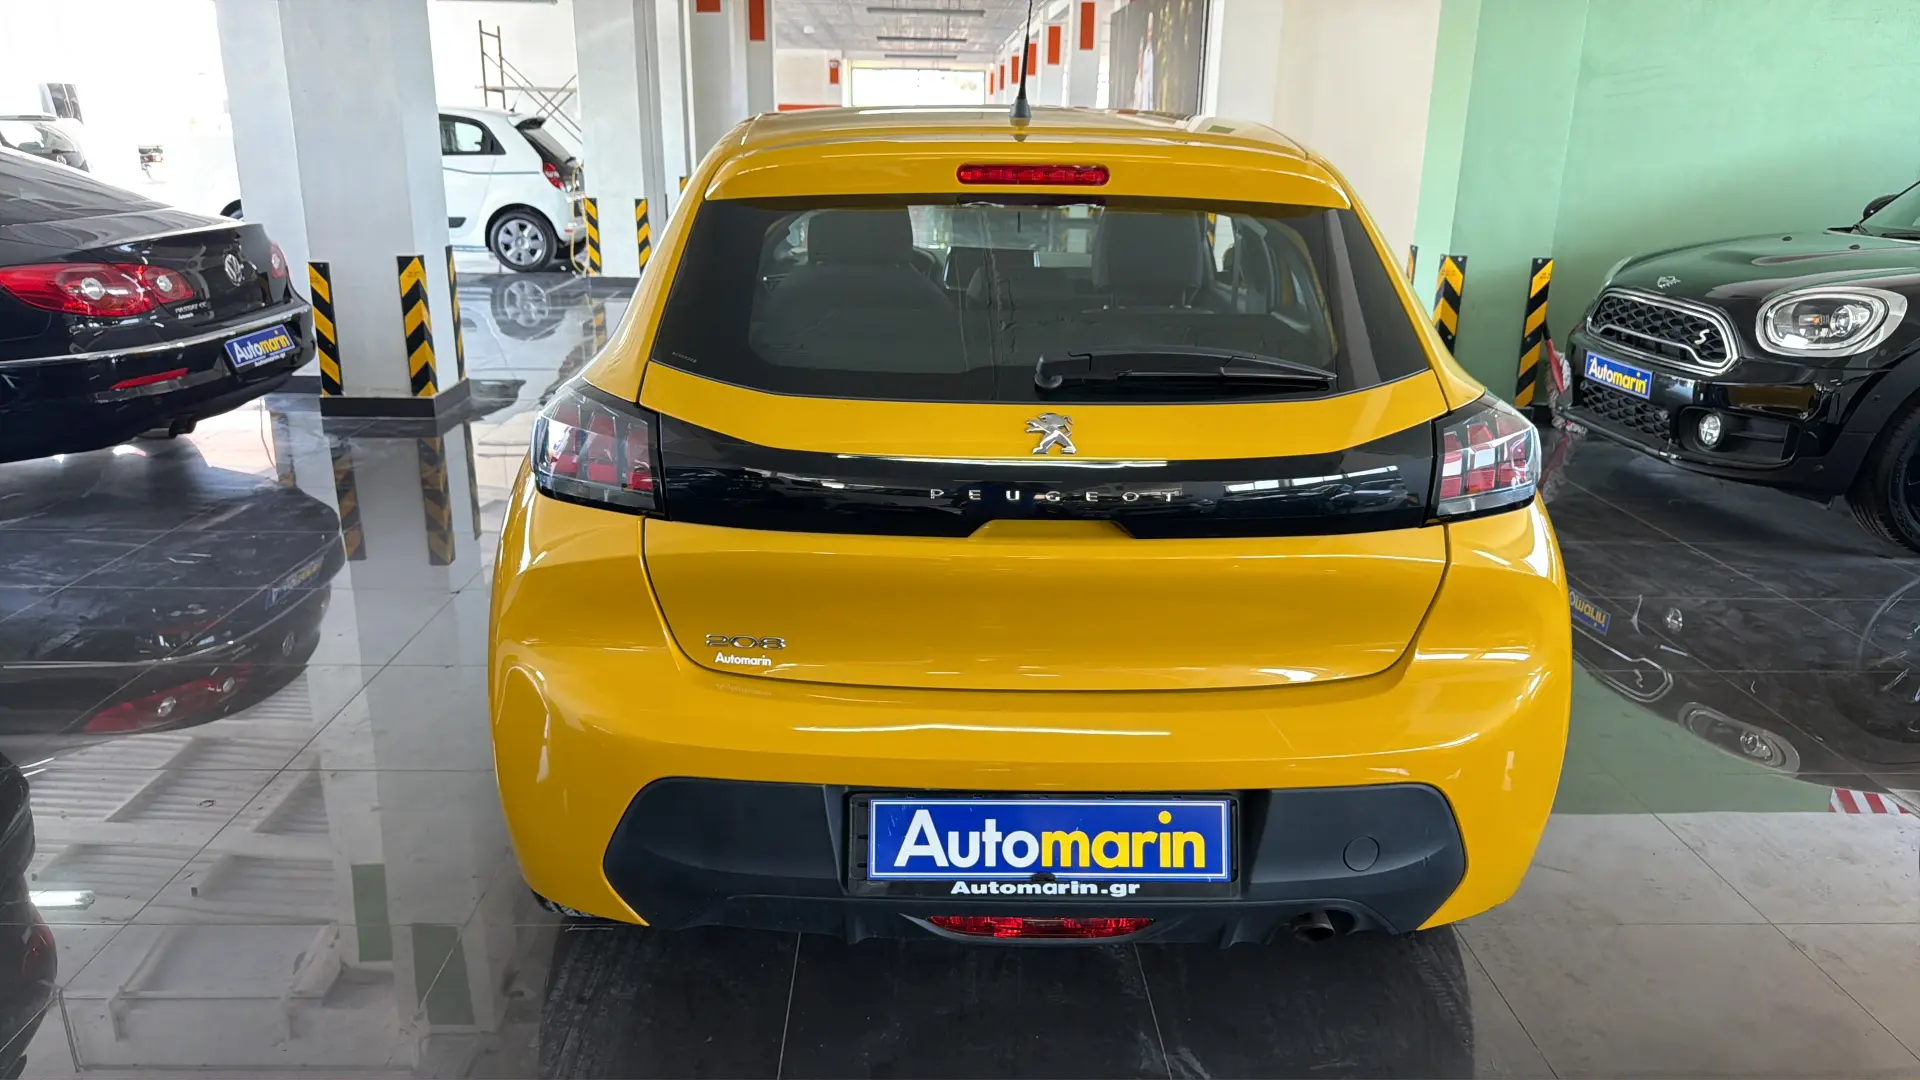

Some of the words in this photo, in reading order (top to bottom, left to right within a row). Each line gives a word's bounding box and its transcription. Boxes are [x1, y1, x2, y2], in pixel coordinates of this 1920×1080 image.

[233, 329, 290, 363] Automarin
[1588, 358, 1648, 395] Automarin
[930, 488, 1179, 502] PEUGEOT
[705, 633, 787, 650] 208
[715, 652, 772, 666] Automarin
[893, 809, 1206, 869] Automarin
[950, 880, 1141, 897] Automarin.gr
